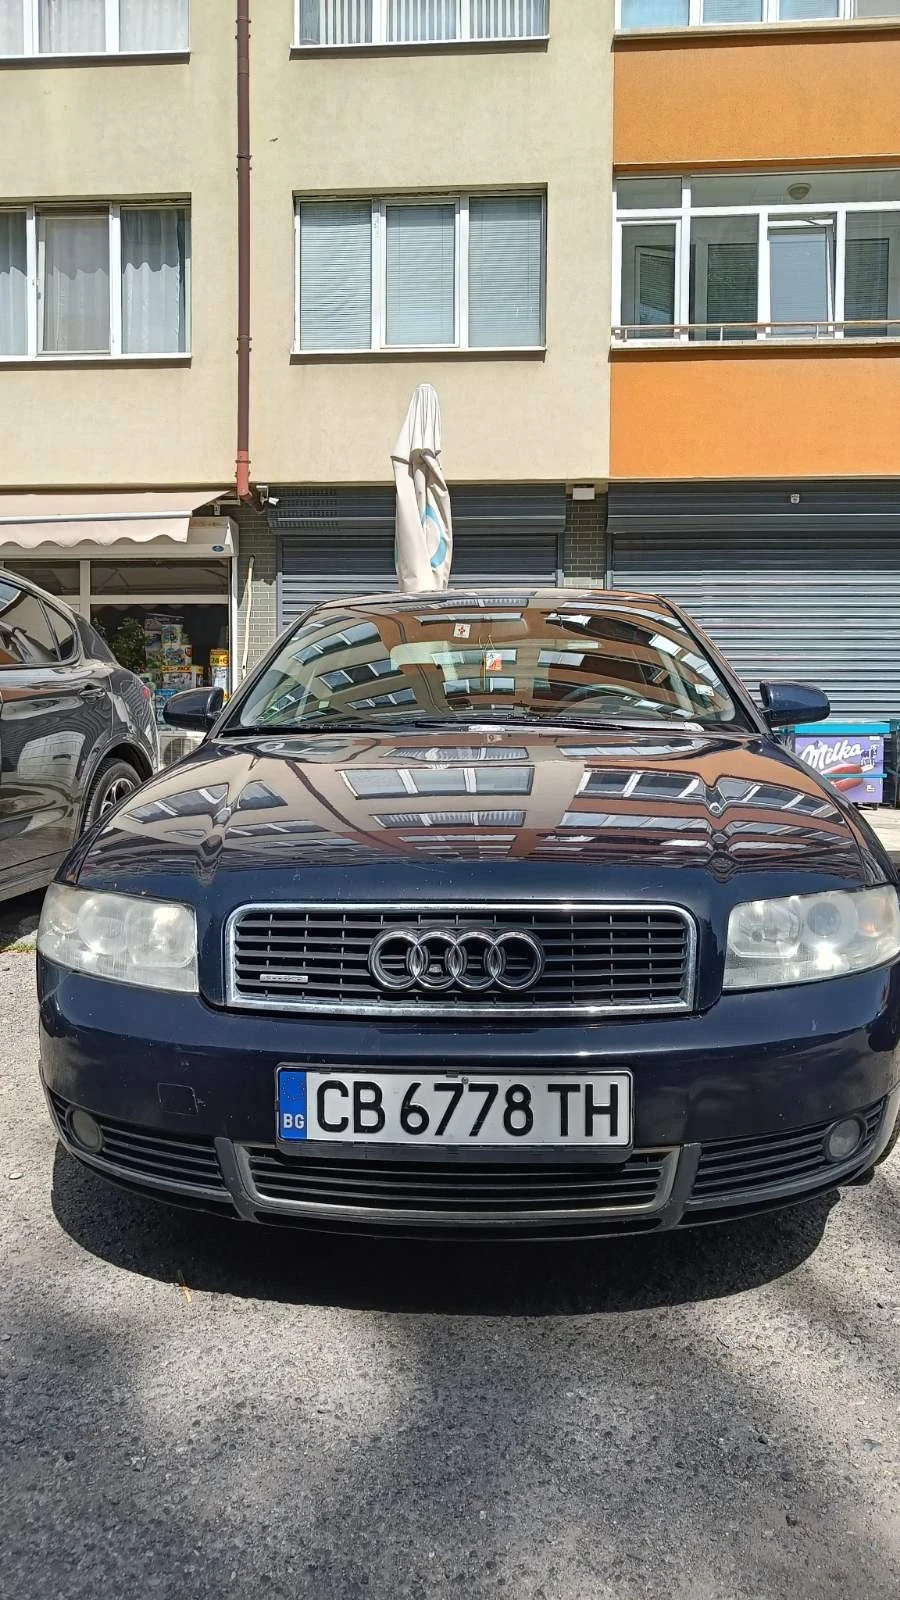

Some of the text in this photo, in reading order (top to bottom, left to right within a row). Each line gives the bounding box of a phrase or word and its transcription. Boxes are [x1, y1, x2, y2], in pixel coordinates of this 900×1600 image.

[800, 740, 864, 770] Milka
[283, 1113, 305, 1129] BG
[317, 1080, 619, 1137] CB 6778 TH
